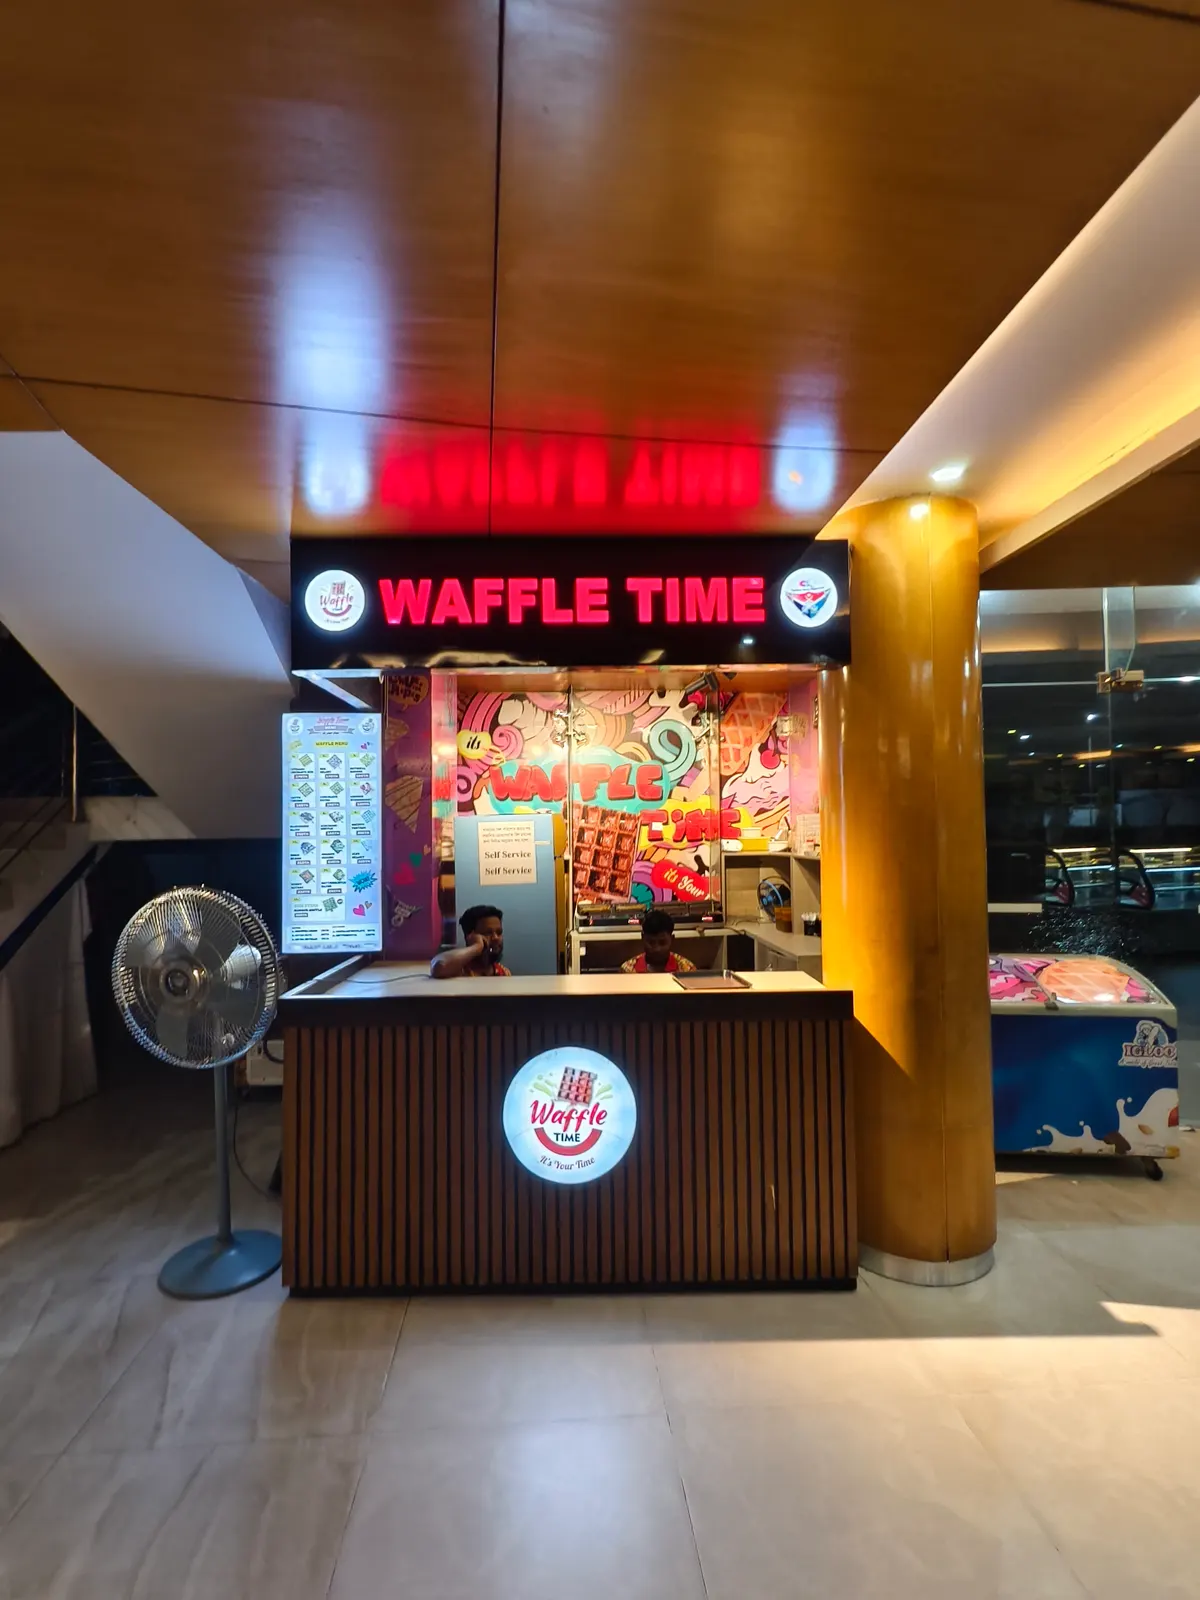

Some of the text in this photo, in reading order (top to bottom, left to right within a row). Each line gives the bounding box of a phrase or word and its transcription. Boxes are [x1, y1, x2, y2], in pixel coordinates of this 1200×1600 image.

[320, 593, 354, 608] Waffle
[378, 576, 767, 626] WAFFLE TIME
[484, 850, 532, 859] Self Service
[485, 866, 533, 876] Self Service
[677, 875, 705, 897] Your
[530, 1099, 608, 1133] Waffle
[553, 1132, 581, 1142] TIME
[539, 1155, 596, 1171] It's Your Time
